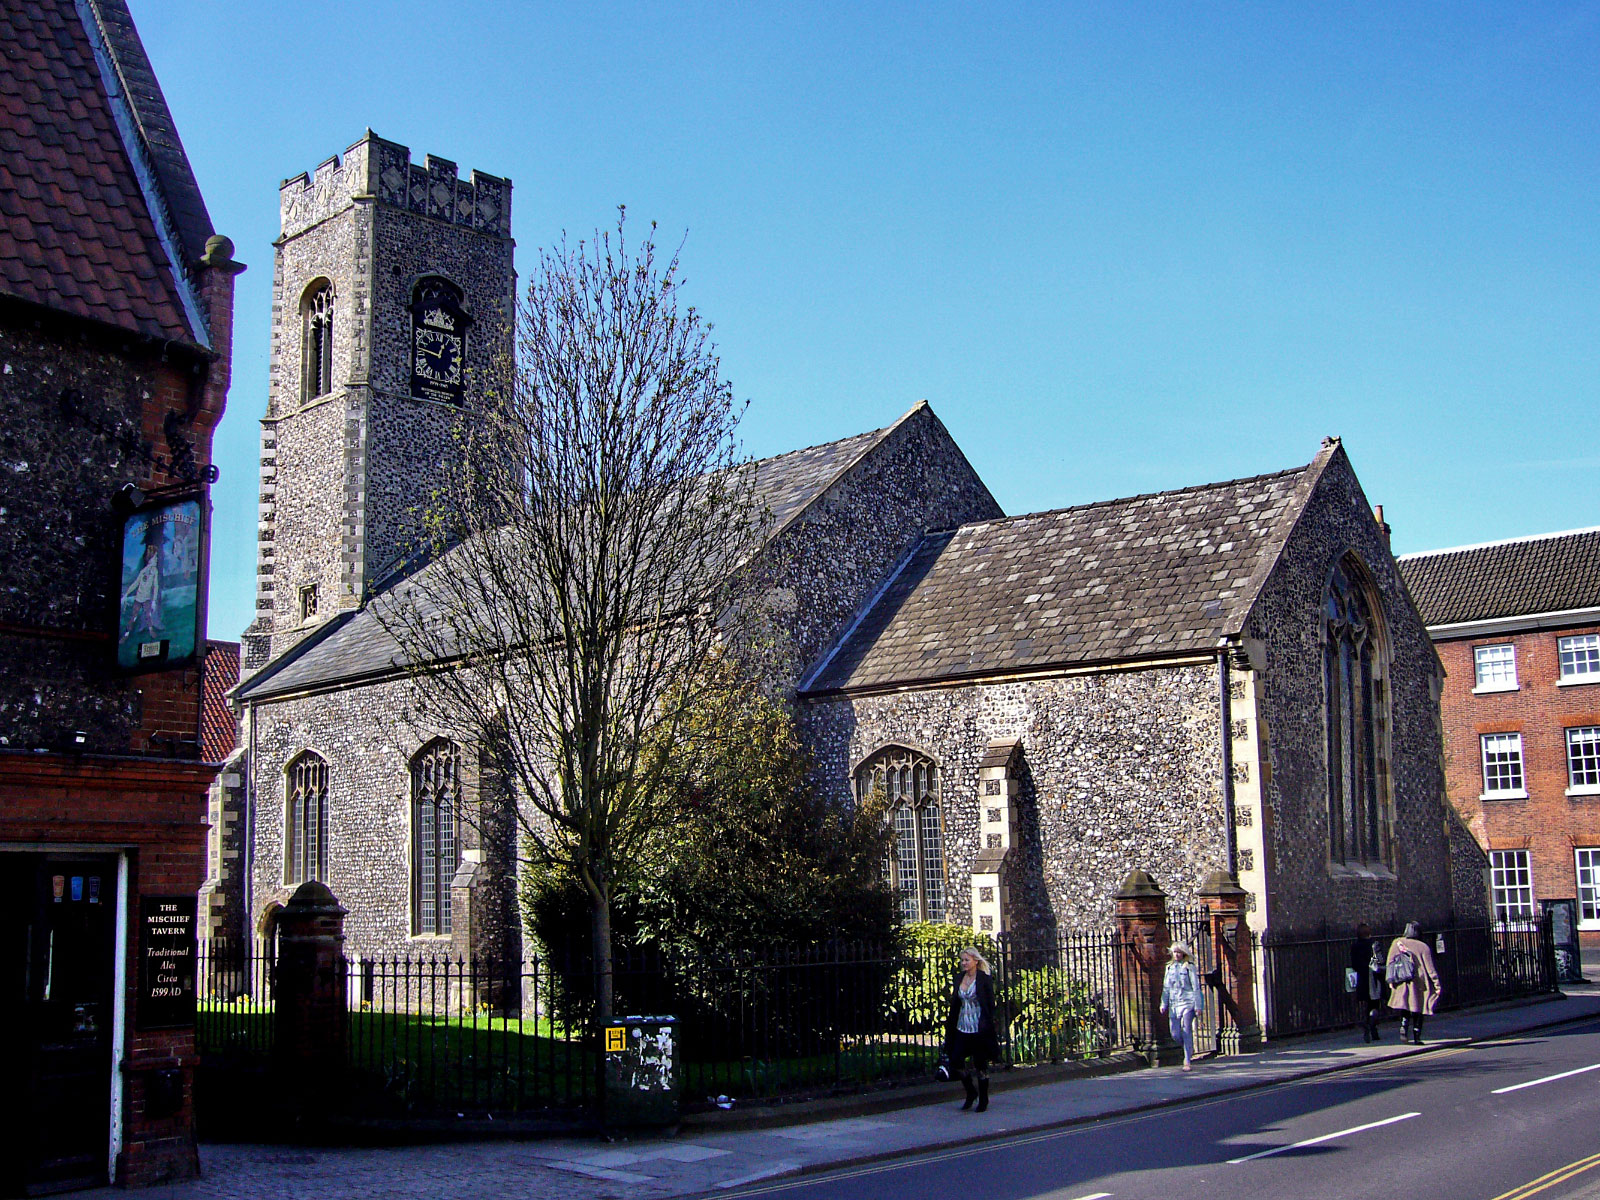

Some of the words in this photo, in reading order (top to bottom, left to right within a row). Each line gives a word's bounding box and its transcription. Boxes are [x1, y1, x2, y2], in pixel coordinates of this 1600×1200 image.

[131, 520, 150, 538] THE
[151, 513, 195, 526] MISCHIEF
[160, 904, 178, 912] THE
[147, 915, 190, 923] MISCHIEF
[151, 927, 186, 935] TAVERN
[147, 947, 189, 957] Traditional
[160, 960, 176, 970] Ales
[157, 973, 178, 983] Circa
[151, 987, 169, 998] 1599
[168, 987, 182, 997] AD
